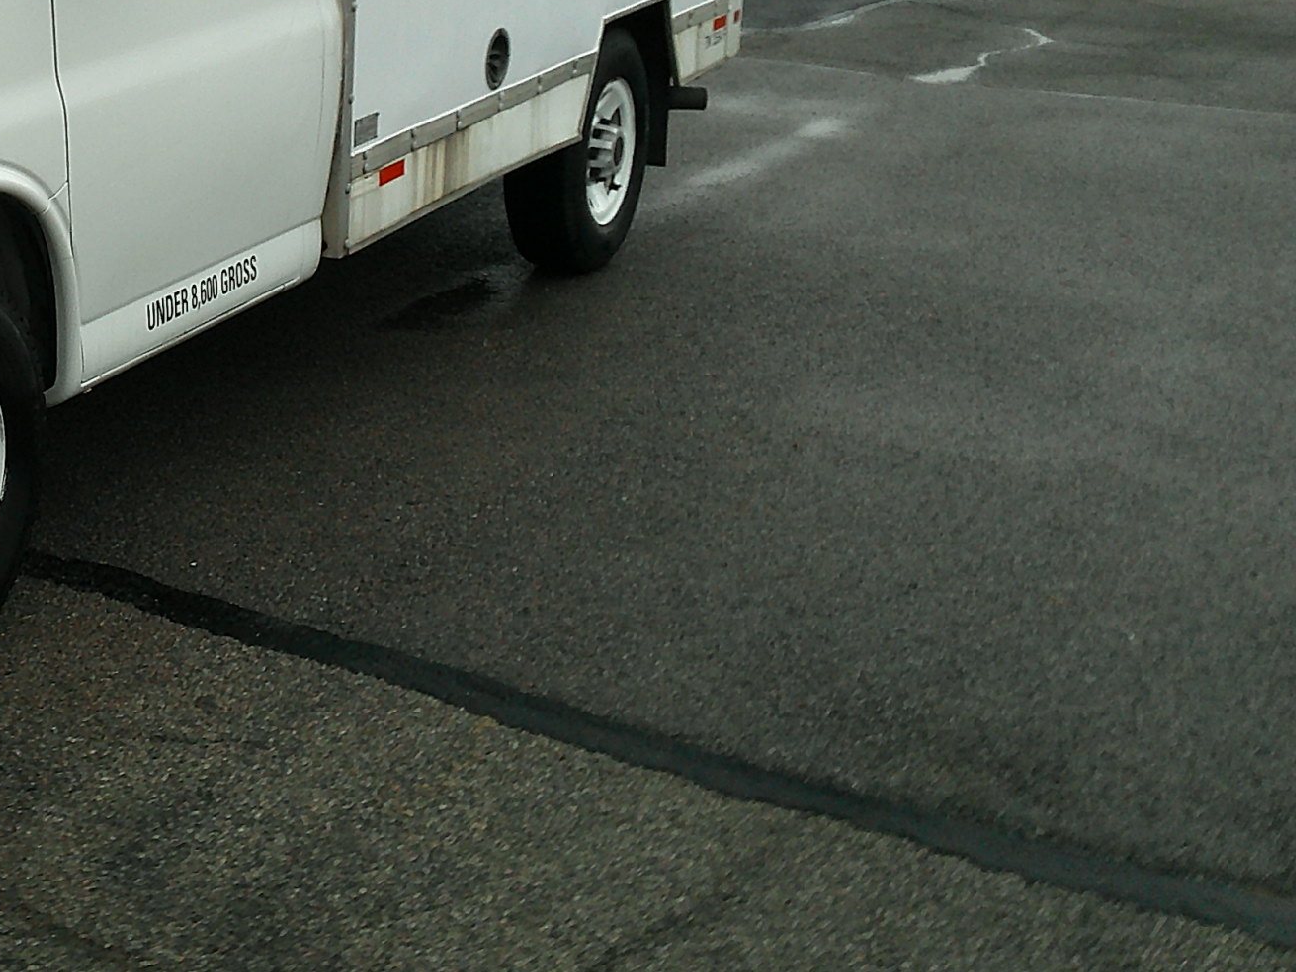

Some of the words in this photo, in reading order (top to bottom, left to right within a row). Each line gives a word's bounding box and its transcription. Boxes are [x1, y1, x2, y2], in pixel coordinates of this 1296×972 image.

[146, 288, 189, 330] UNDER
[191, 274, 218, 310] 8,600
[220, 255, 257, 294] GROSS
